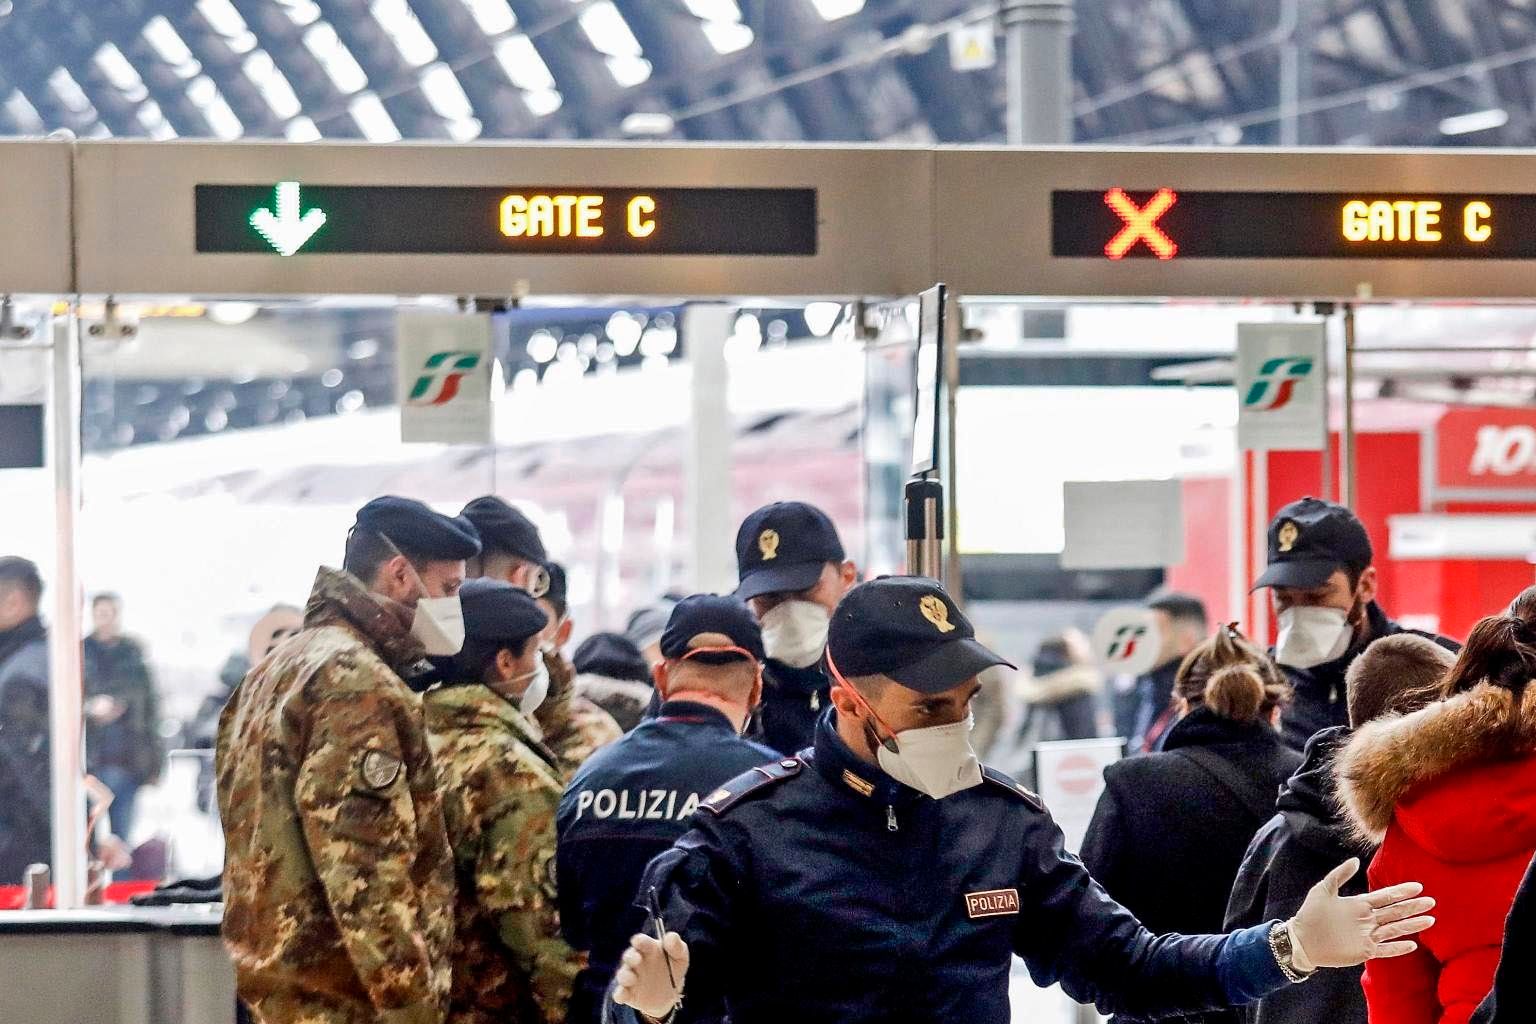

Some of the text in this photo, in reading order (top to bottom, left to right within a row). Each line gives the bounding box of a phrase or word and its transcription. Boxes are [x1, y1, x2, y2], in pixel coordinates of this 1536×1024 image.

[500, 194, 656, 238] GATE C
[1342, 200, 1491, 242] GATE C
[576, 788, 700, 820] POLIZIA
[970, 894, 1017, 911] POLIZIA
